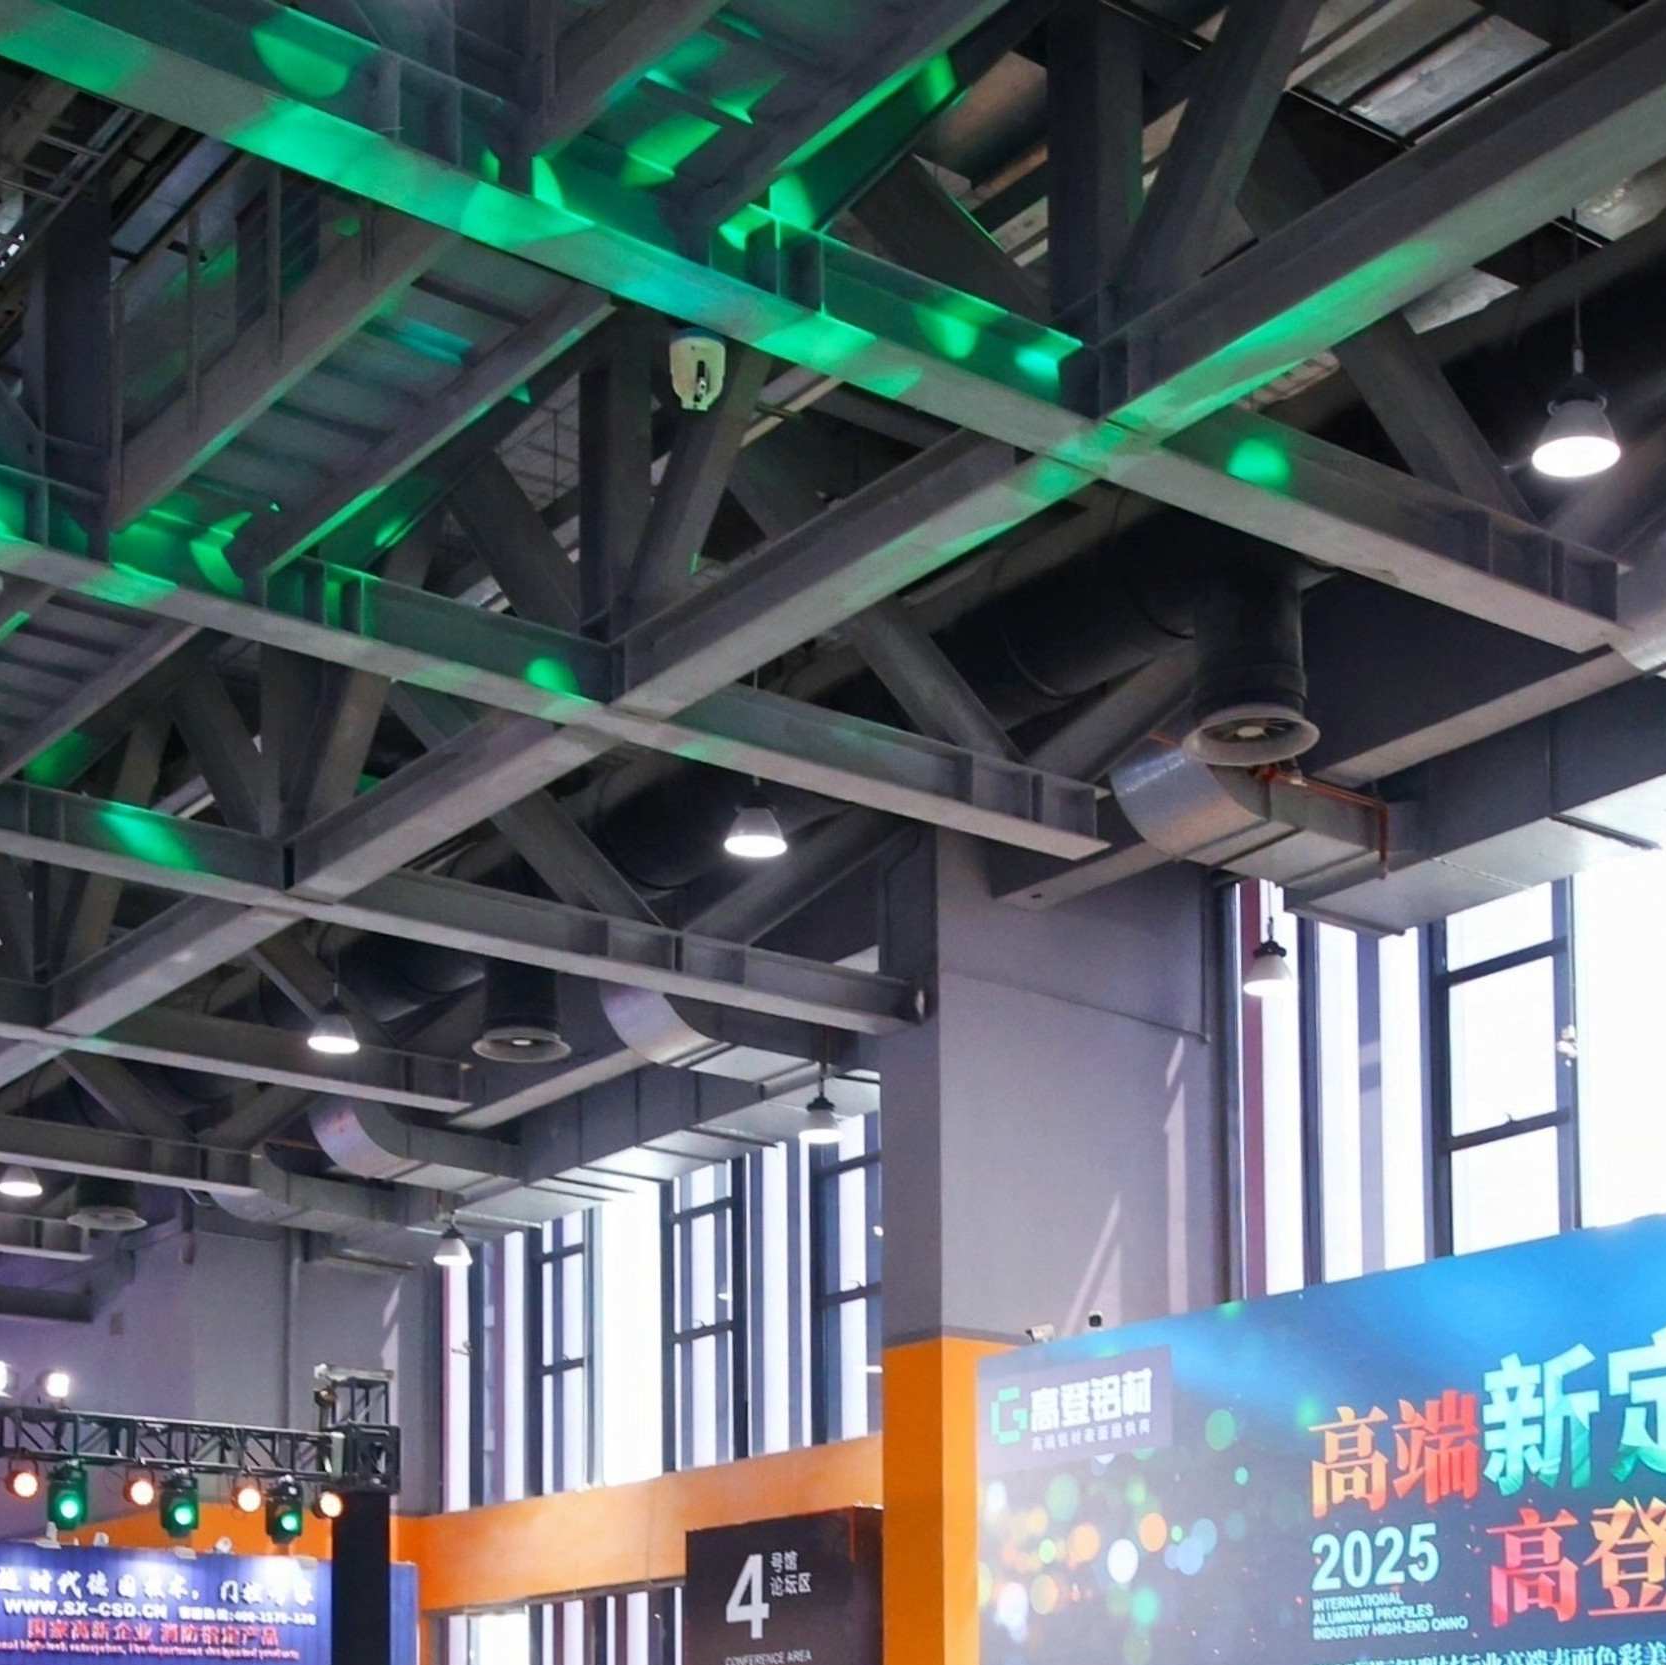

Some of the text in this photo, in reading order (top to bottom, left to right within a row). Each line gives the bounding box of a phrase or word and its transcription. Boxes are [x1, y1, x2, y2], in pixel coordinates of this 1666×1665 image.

[1311, 1522, 1440, 1592] 2025
[725, 1553, 770, 1640] 4
[1312, 1592, 1404, 1611] INTERNATIONAL
[1313, 1603, 1434, 1626] ALUMINUM PROFILES
[1313, 1624, 1370, 1641] INDUSTRY
[1372, 1618, 1430, 1636] HIGH-END
[787, 1650, 812, 1663] AREA
